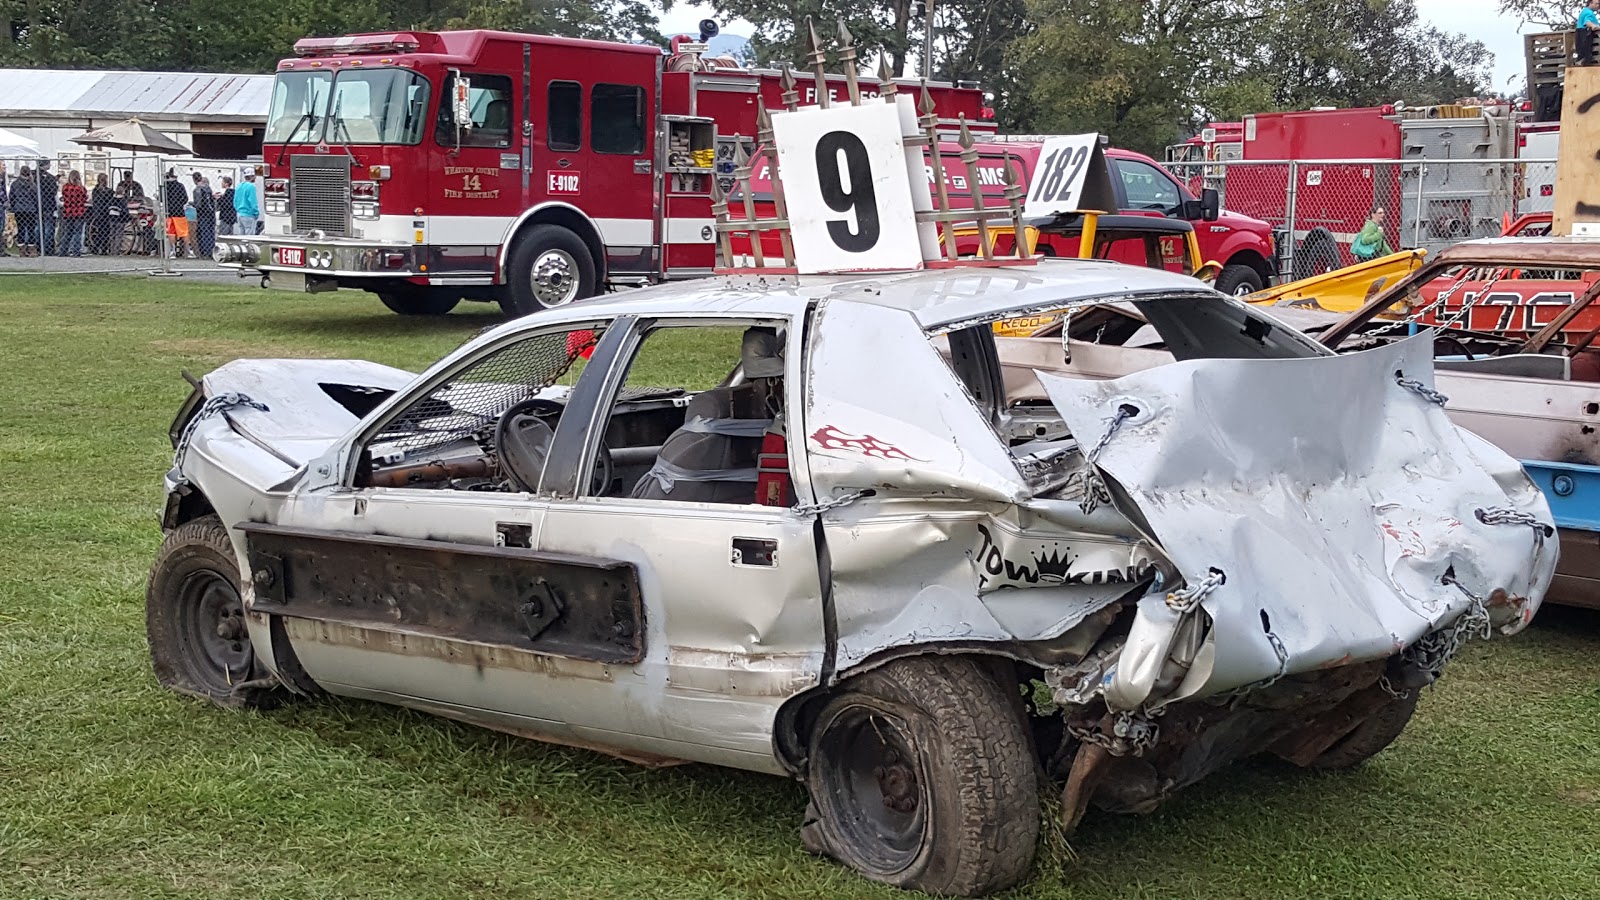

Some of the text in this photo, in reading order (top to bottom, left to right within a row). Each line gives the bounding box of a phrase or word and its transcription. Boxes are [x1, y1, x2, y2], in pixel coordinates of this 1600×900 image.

[806, 87, 837, 104] FIE
[476, 167, 499, 177] COUNTY
[1032, 146, 1088, 202] 182
[462, 174, 482, 190] 14
[550, 174, 579, 191] E-9102
[444, 188, 499, 198] FIRE DISTRICT
[815, 130, 880, 253] 9
[282, 248, 302, 265] E-9102
[1160, 240, 1174, 256] 14
[977, 523, 1039, 584] TOW
